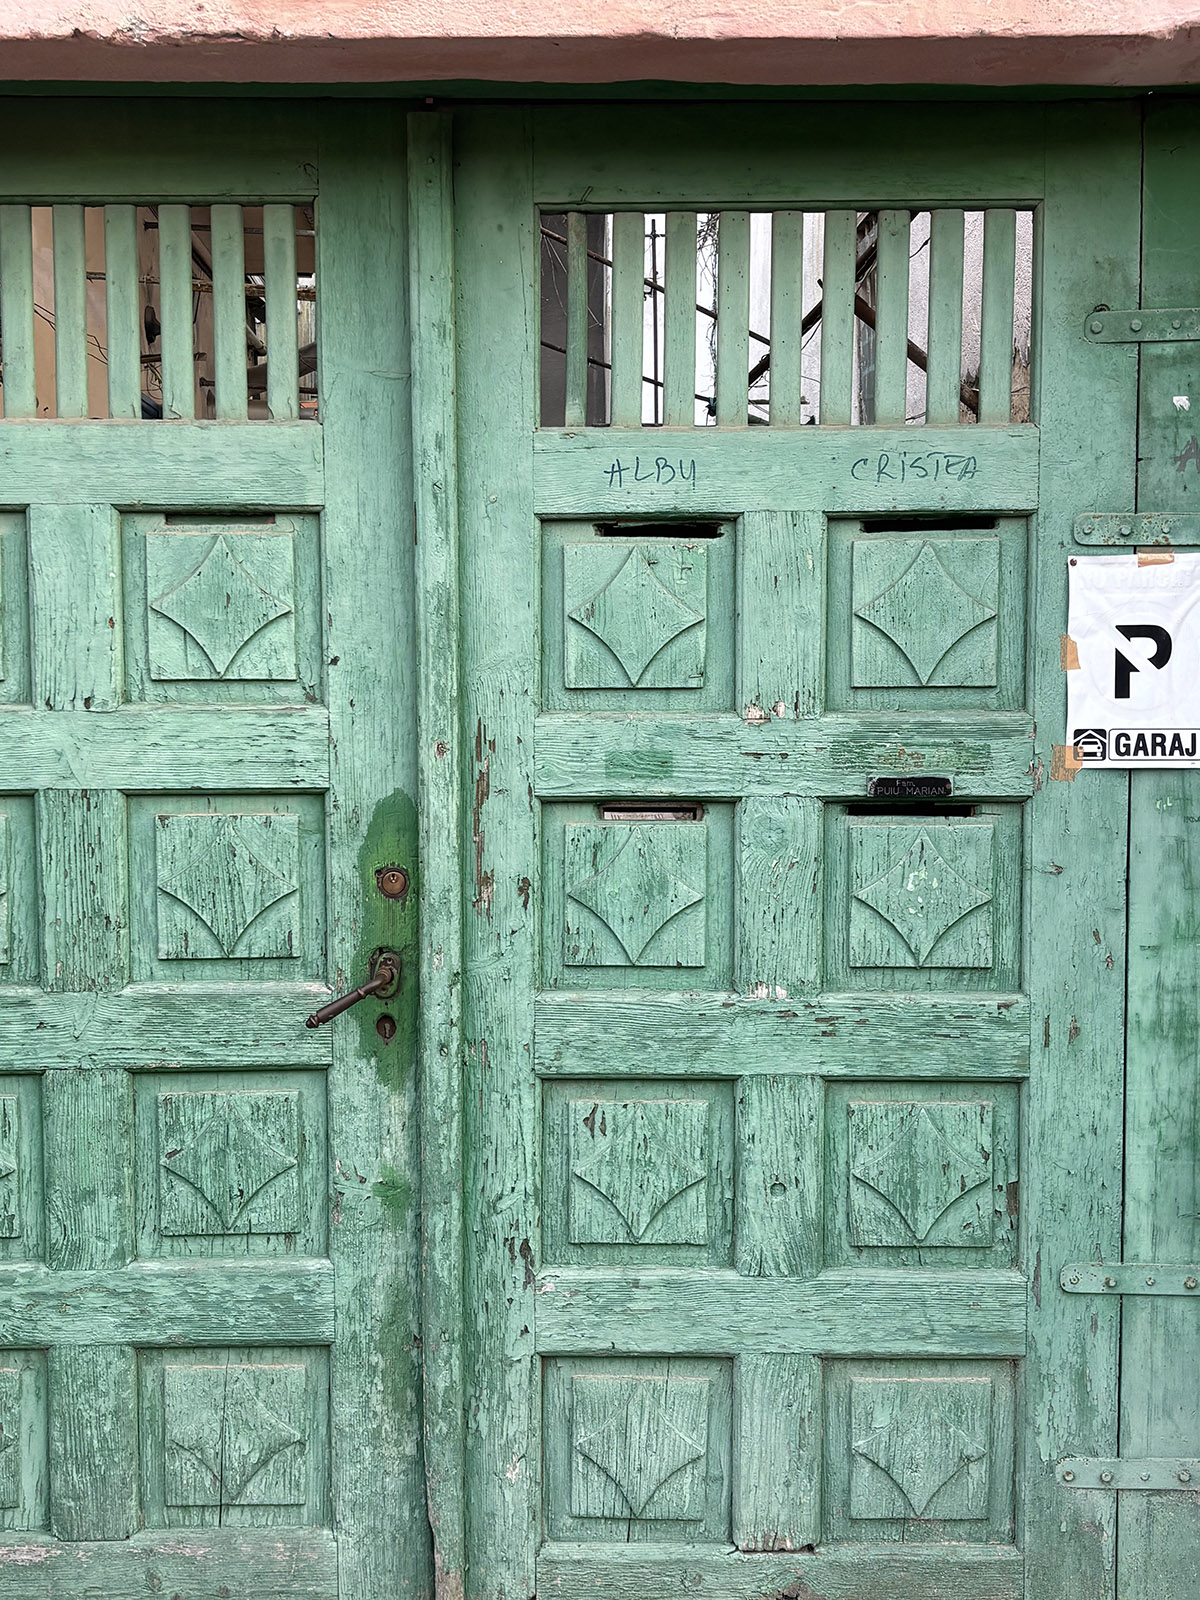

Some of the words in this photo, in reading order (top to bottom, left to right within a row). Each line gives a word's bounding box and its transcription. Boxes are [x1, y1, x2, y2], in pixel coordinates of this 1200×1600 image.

[850, 451, 982, 483] CRISTEA
[1115, 624, 1173, 699] P
[1115, 732, 1197, 757] GARAJ
[877, 786, 900, 795] PUIU
